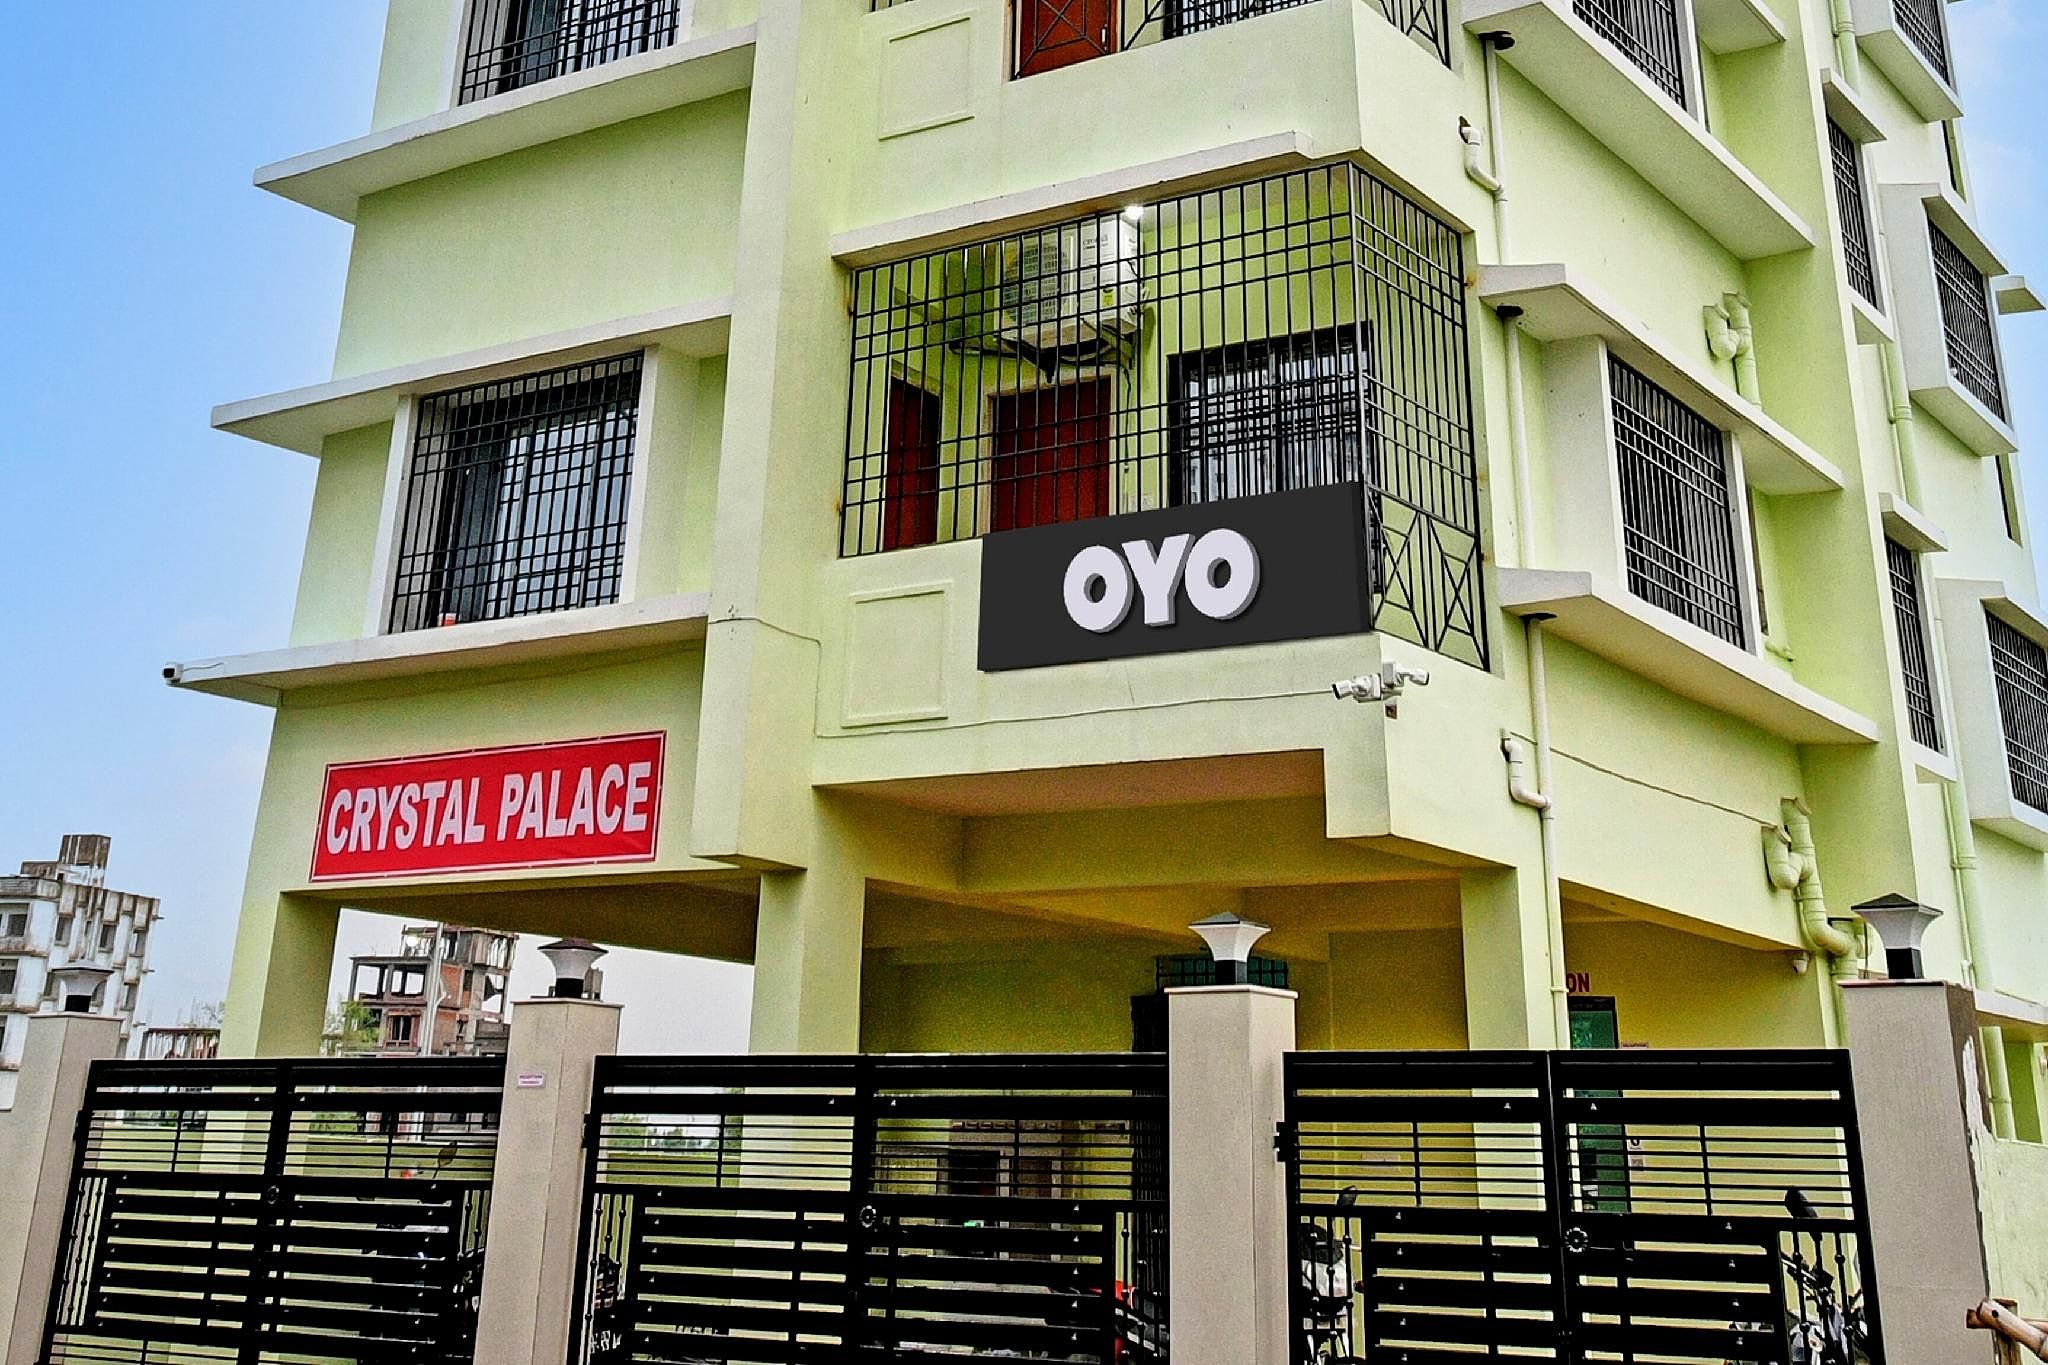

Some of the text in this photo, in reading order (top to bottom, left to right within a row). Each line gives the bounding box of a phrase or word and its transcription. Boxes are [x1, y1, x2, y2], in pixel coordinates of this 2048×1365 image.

[1063, 528, 1260, 633] OYO
[326, 761, 651, 855] CRYSTAL PALACE
